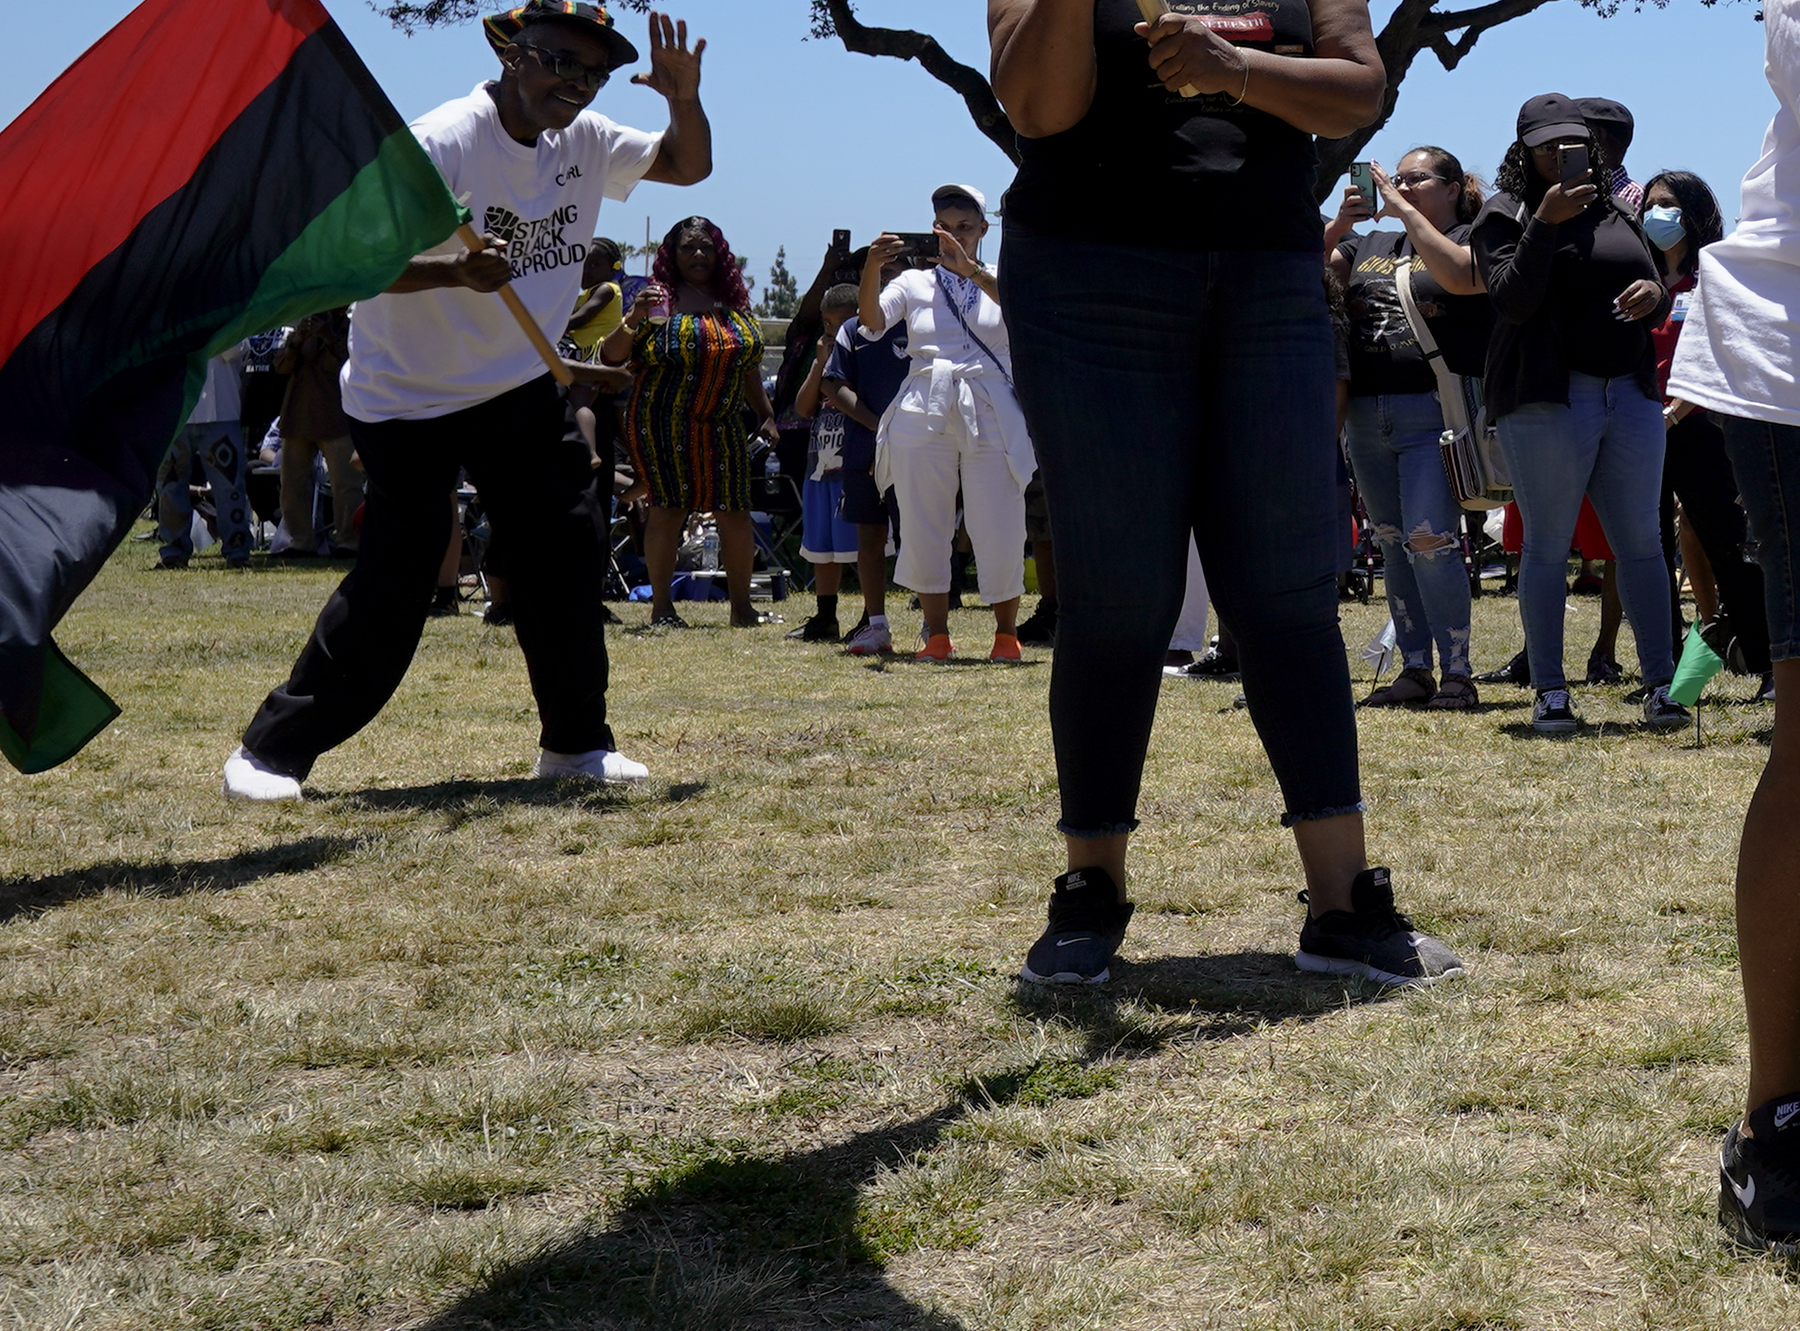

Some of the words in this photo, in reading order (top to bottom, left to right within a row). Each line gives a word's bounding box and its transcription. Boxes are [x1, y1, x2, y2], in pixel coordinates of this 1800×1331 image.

[1197, 2, 1210, 12] the
[1212, 1, 1241, 14] Ending
[510, 227, 569, 259] BLACK
[1776, 1101, 1800, 1116] NIKE
